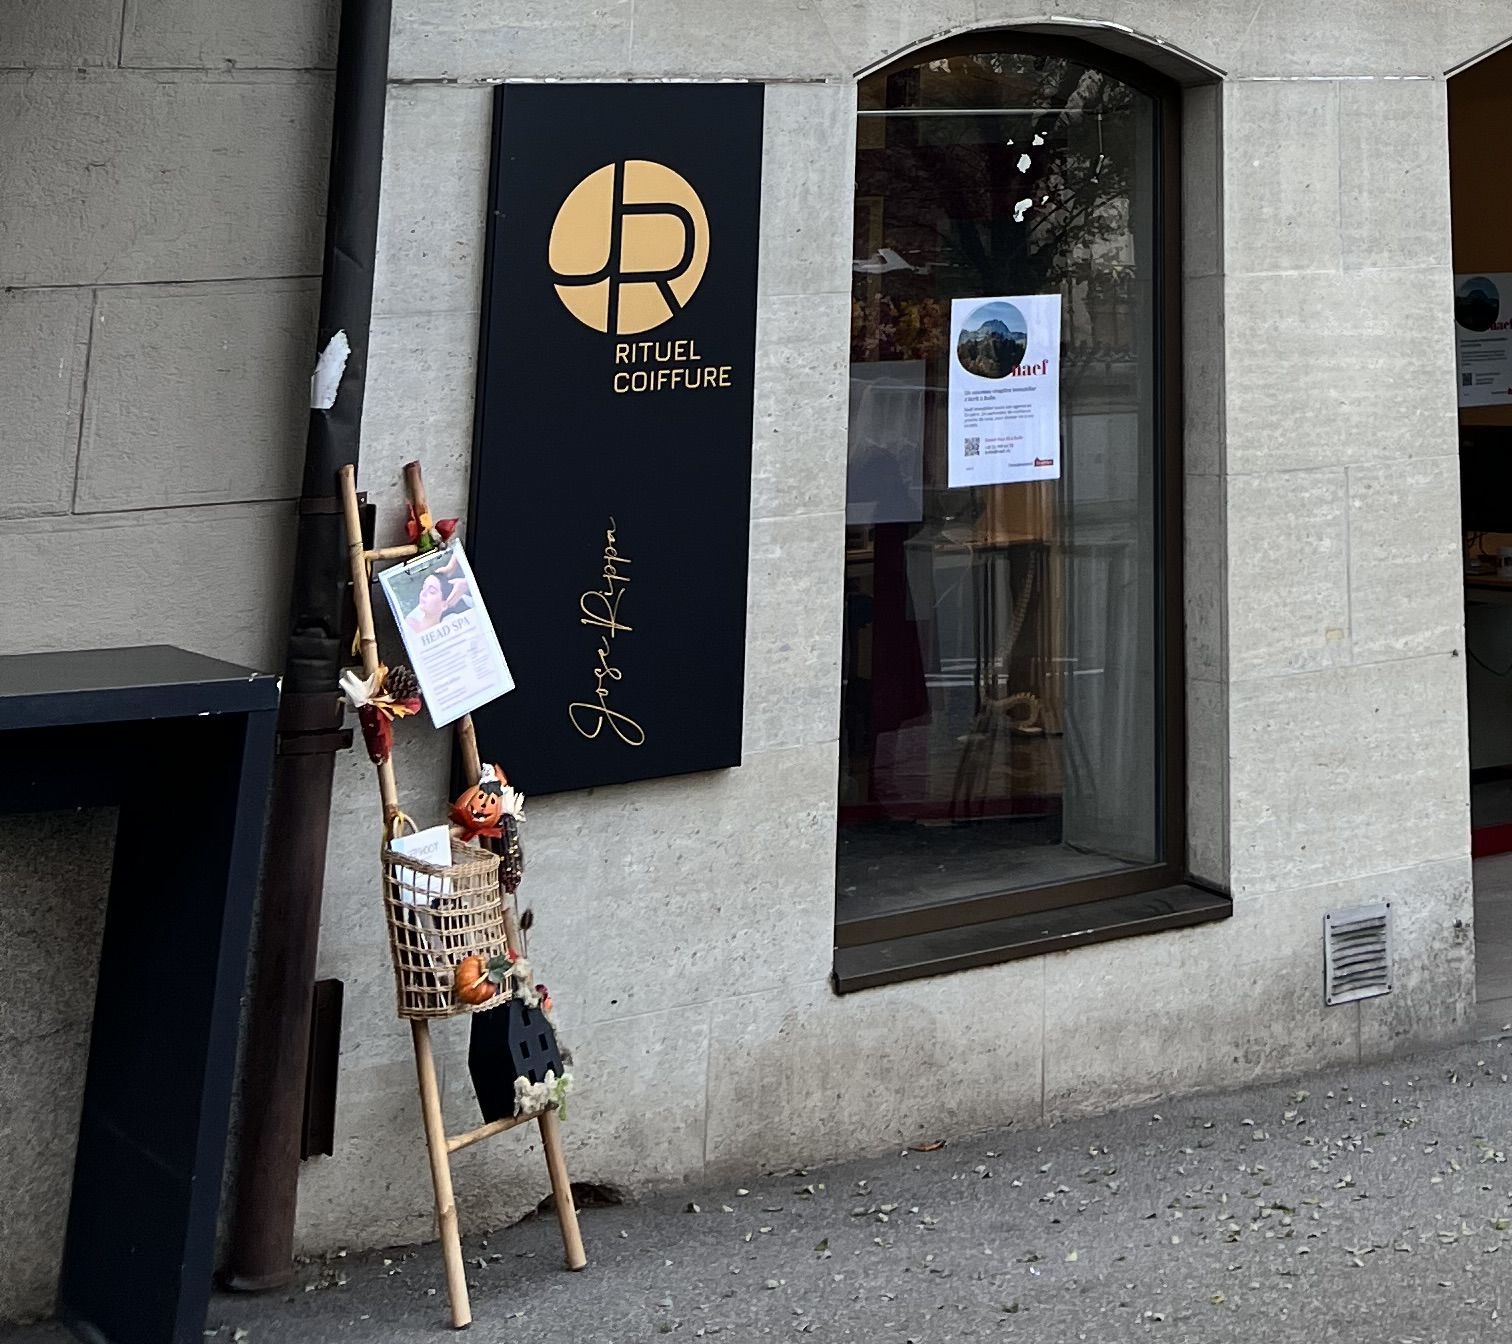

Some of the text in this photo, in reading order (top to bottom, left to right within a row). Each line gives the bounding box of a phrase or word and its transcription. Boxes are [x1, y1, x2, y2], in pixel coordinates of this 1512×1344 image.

[614, 339, 703, 365] RITUEL
[613, 365, 733, 394] COIFFURE
[420, 615, 472, 647] HEAD SPA
